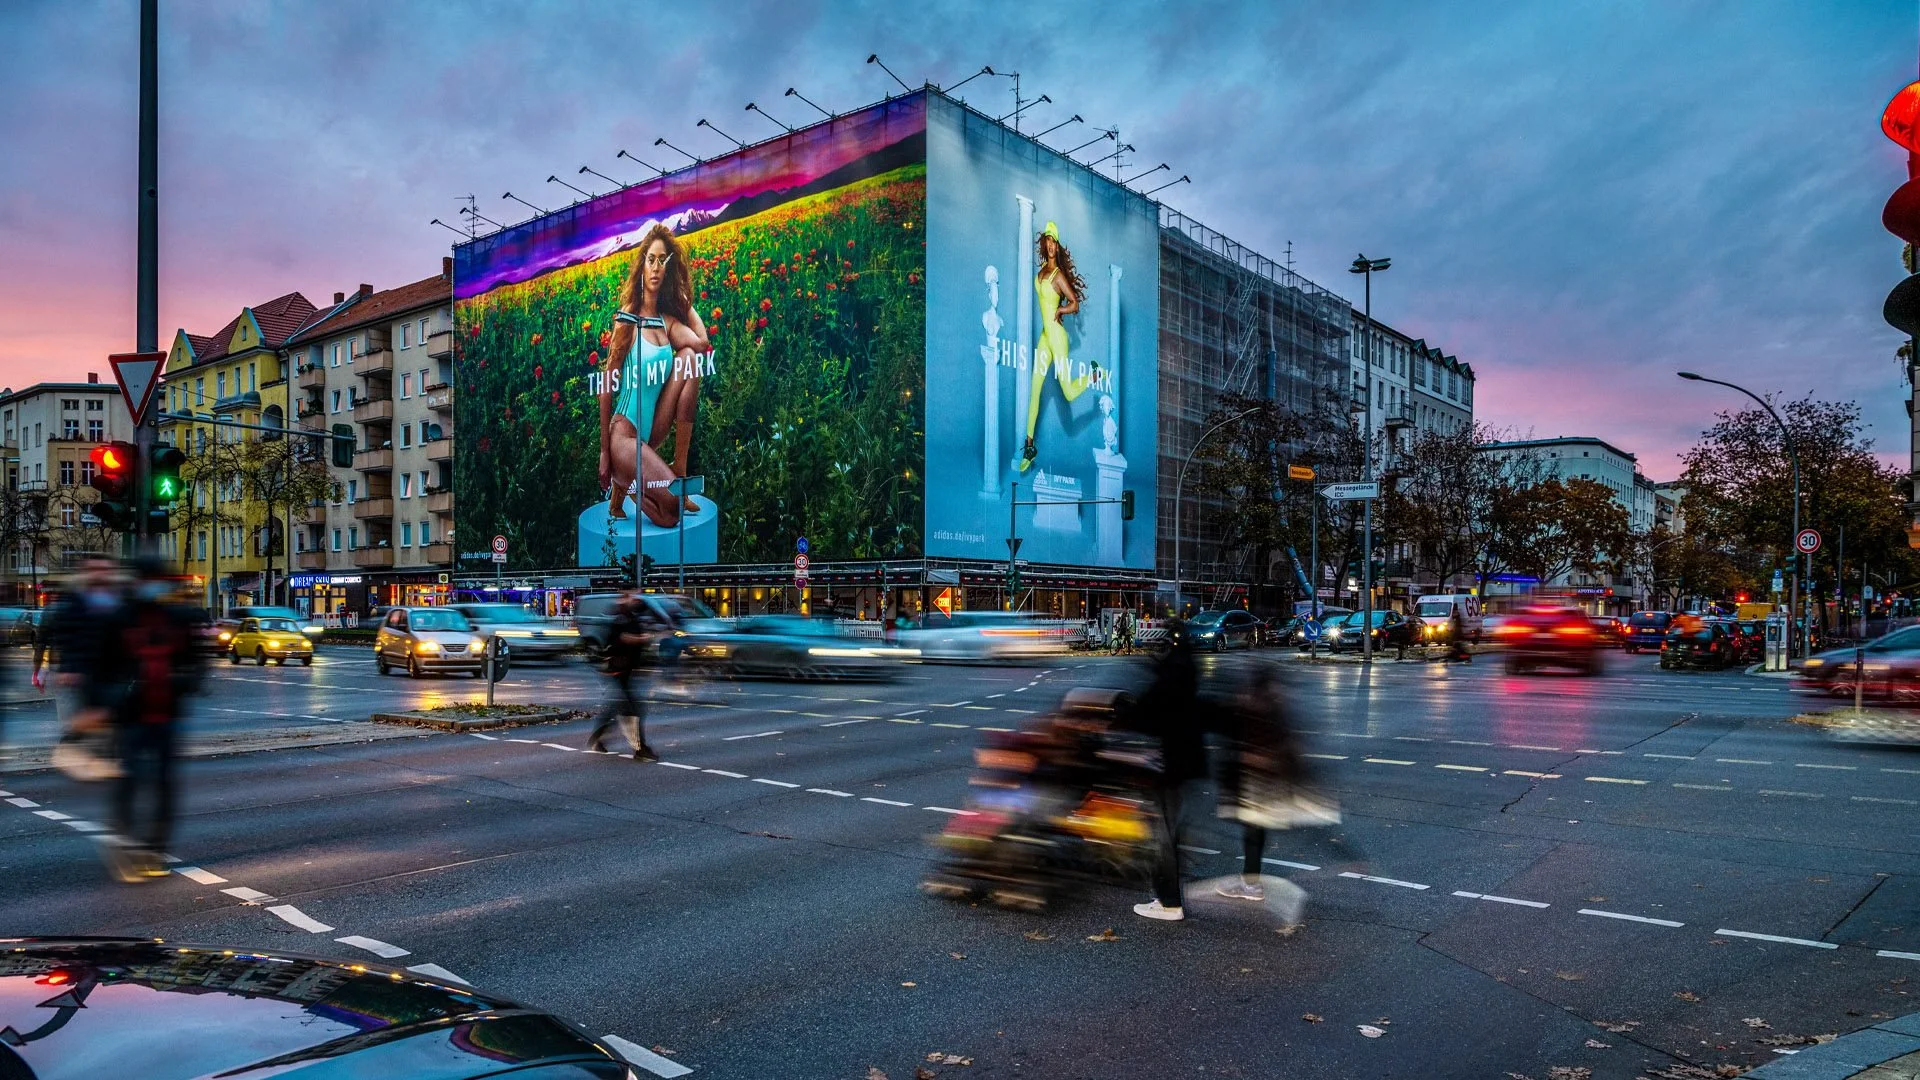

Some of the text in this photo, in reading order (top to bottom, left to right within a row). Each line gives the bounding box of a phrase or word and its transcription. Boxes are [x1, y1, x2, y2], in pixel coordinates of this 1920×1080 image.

[994, 337, 1113, 394] THIS IS MY PARK
[588, 350, 716, 396] THIS IS MY PARK
[1335, 485, 1374, 493] Messegelände
[496, 540, 504, 549] 30
[1801, 536, 1816, 546] 30
[798, 558, 806, 566] 30
